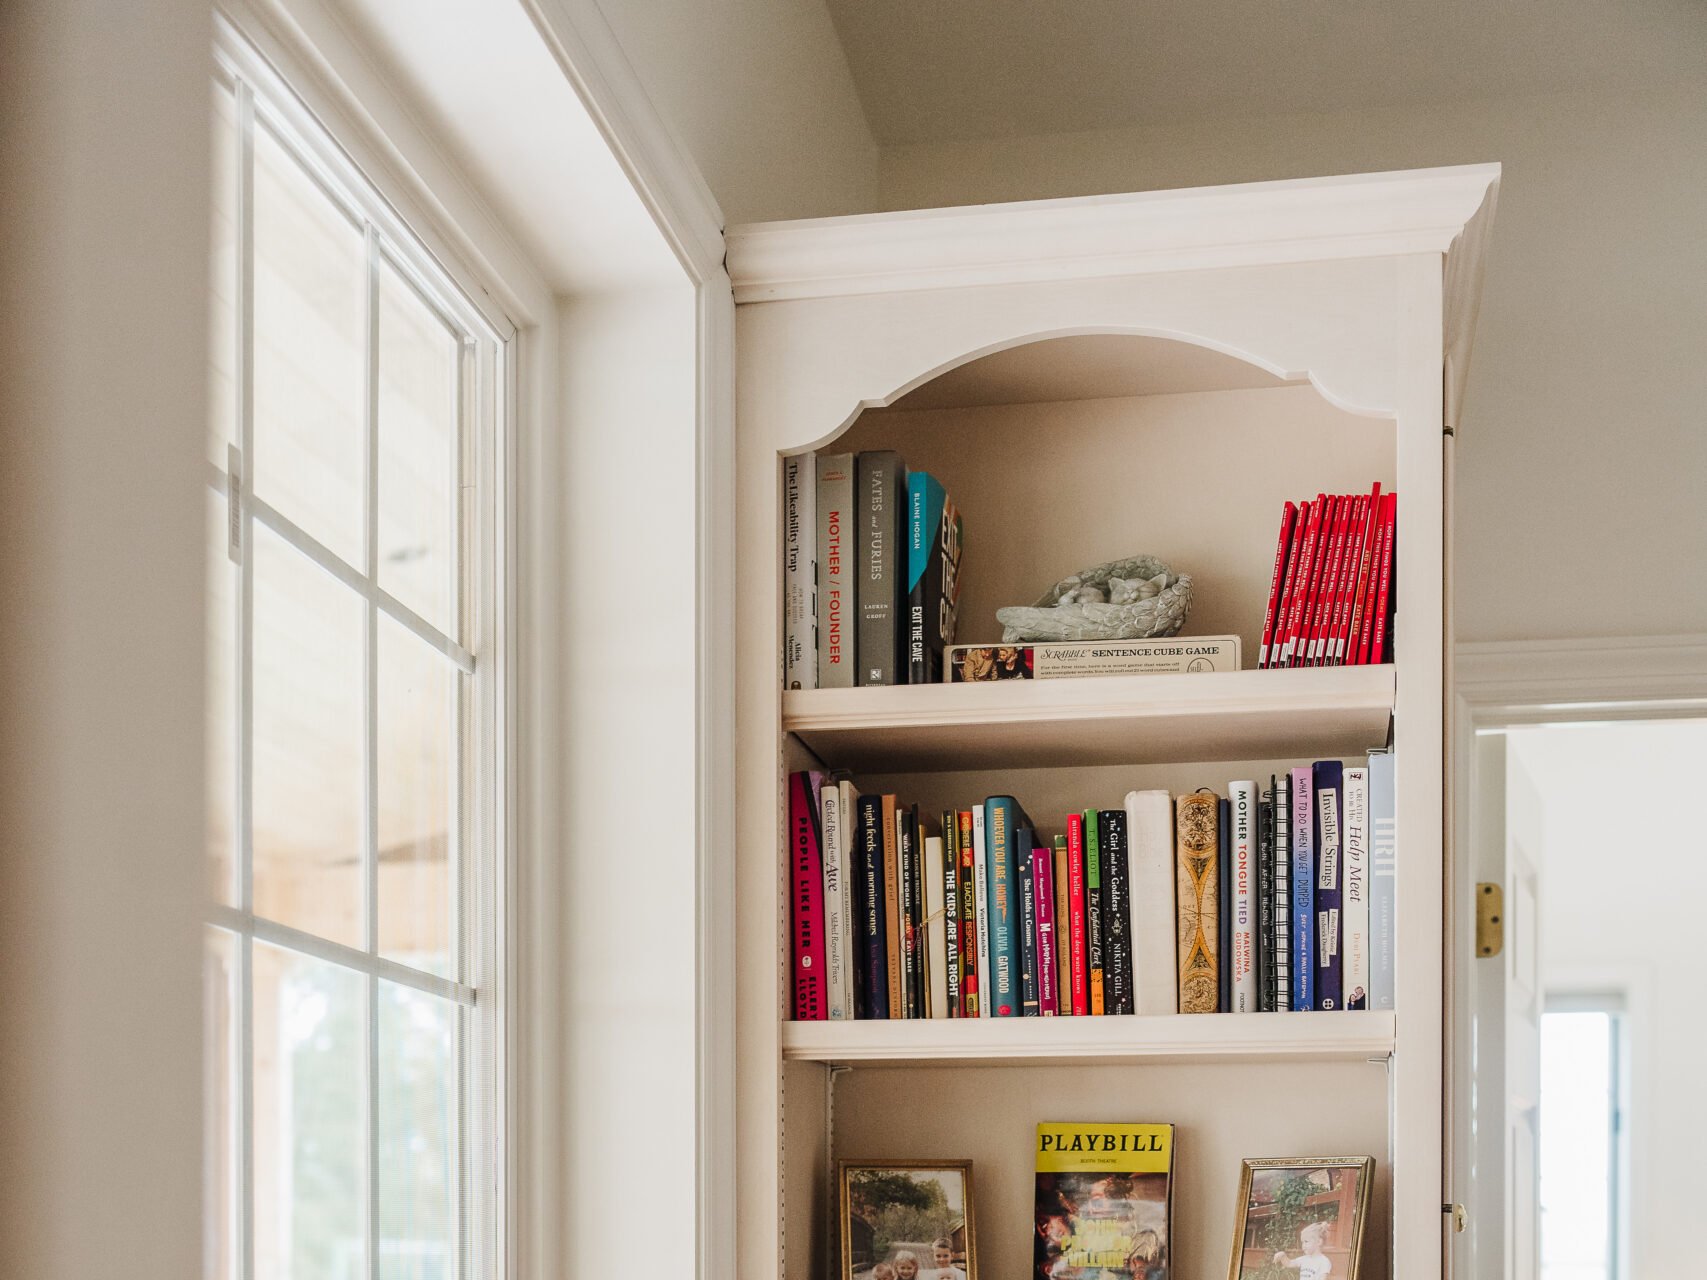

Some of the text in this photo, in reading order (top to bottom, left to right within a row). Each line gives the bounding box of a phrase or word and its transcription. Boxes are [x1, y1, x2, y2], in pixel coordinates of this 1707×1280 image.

[788, 462, 798, 484] The
[872, 470, 882, 512] FATES
[788, 486, 800, 544] Likeability
[788, 545, 800, 572] Trap
[828, 511, 840, 575] MOTHER
[871, 532, 882, 580] FURIES
[830, 590, 840, 664] FOUNDER
[912, 606, 922, 662] EXIT THE CAVE
[1041, 649, 1087, 661] SCRABBLE
[1092, 649, 1151, 657] SENTENCE
[864, 804, 875, 826] night
[826, 825, 836, 849] Round
[867, 829, 876, 852] feeds
[1110, 833, 1118, 850] Girl
[1298, 778, 1309, 907] WHAT TO DO WHEN YOU GET DUMPED
[1322, 794, 1337, 887] Invisible Strings
[826, 862, 838, 891] Awe
[828, 850, 836, 864] with
[1238, 791, 1247, 924] MOTHER TONGUE TIED
[1347, 827, 1364, 902] Help Meet
[799, 817, 810, 947] PEOPLE LIKE HER
[868, 872, 877, 908] morning
[994, 808, 1009, 993] WHOEVER YOU ARE, HONEY OLIVIA GATWOOD
[1111, 877, 1120, 911] Goddess
[946, 870, 958, 996] THE KIDS ARE ALL RIGHT
[1090, 907, 1100, 946] Confidential
[1090, 947, 1102, 965] Clerk
[1040, 1135, 1162, 1151] PLAYBILL
